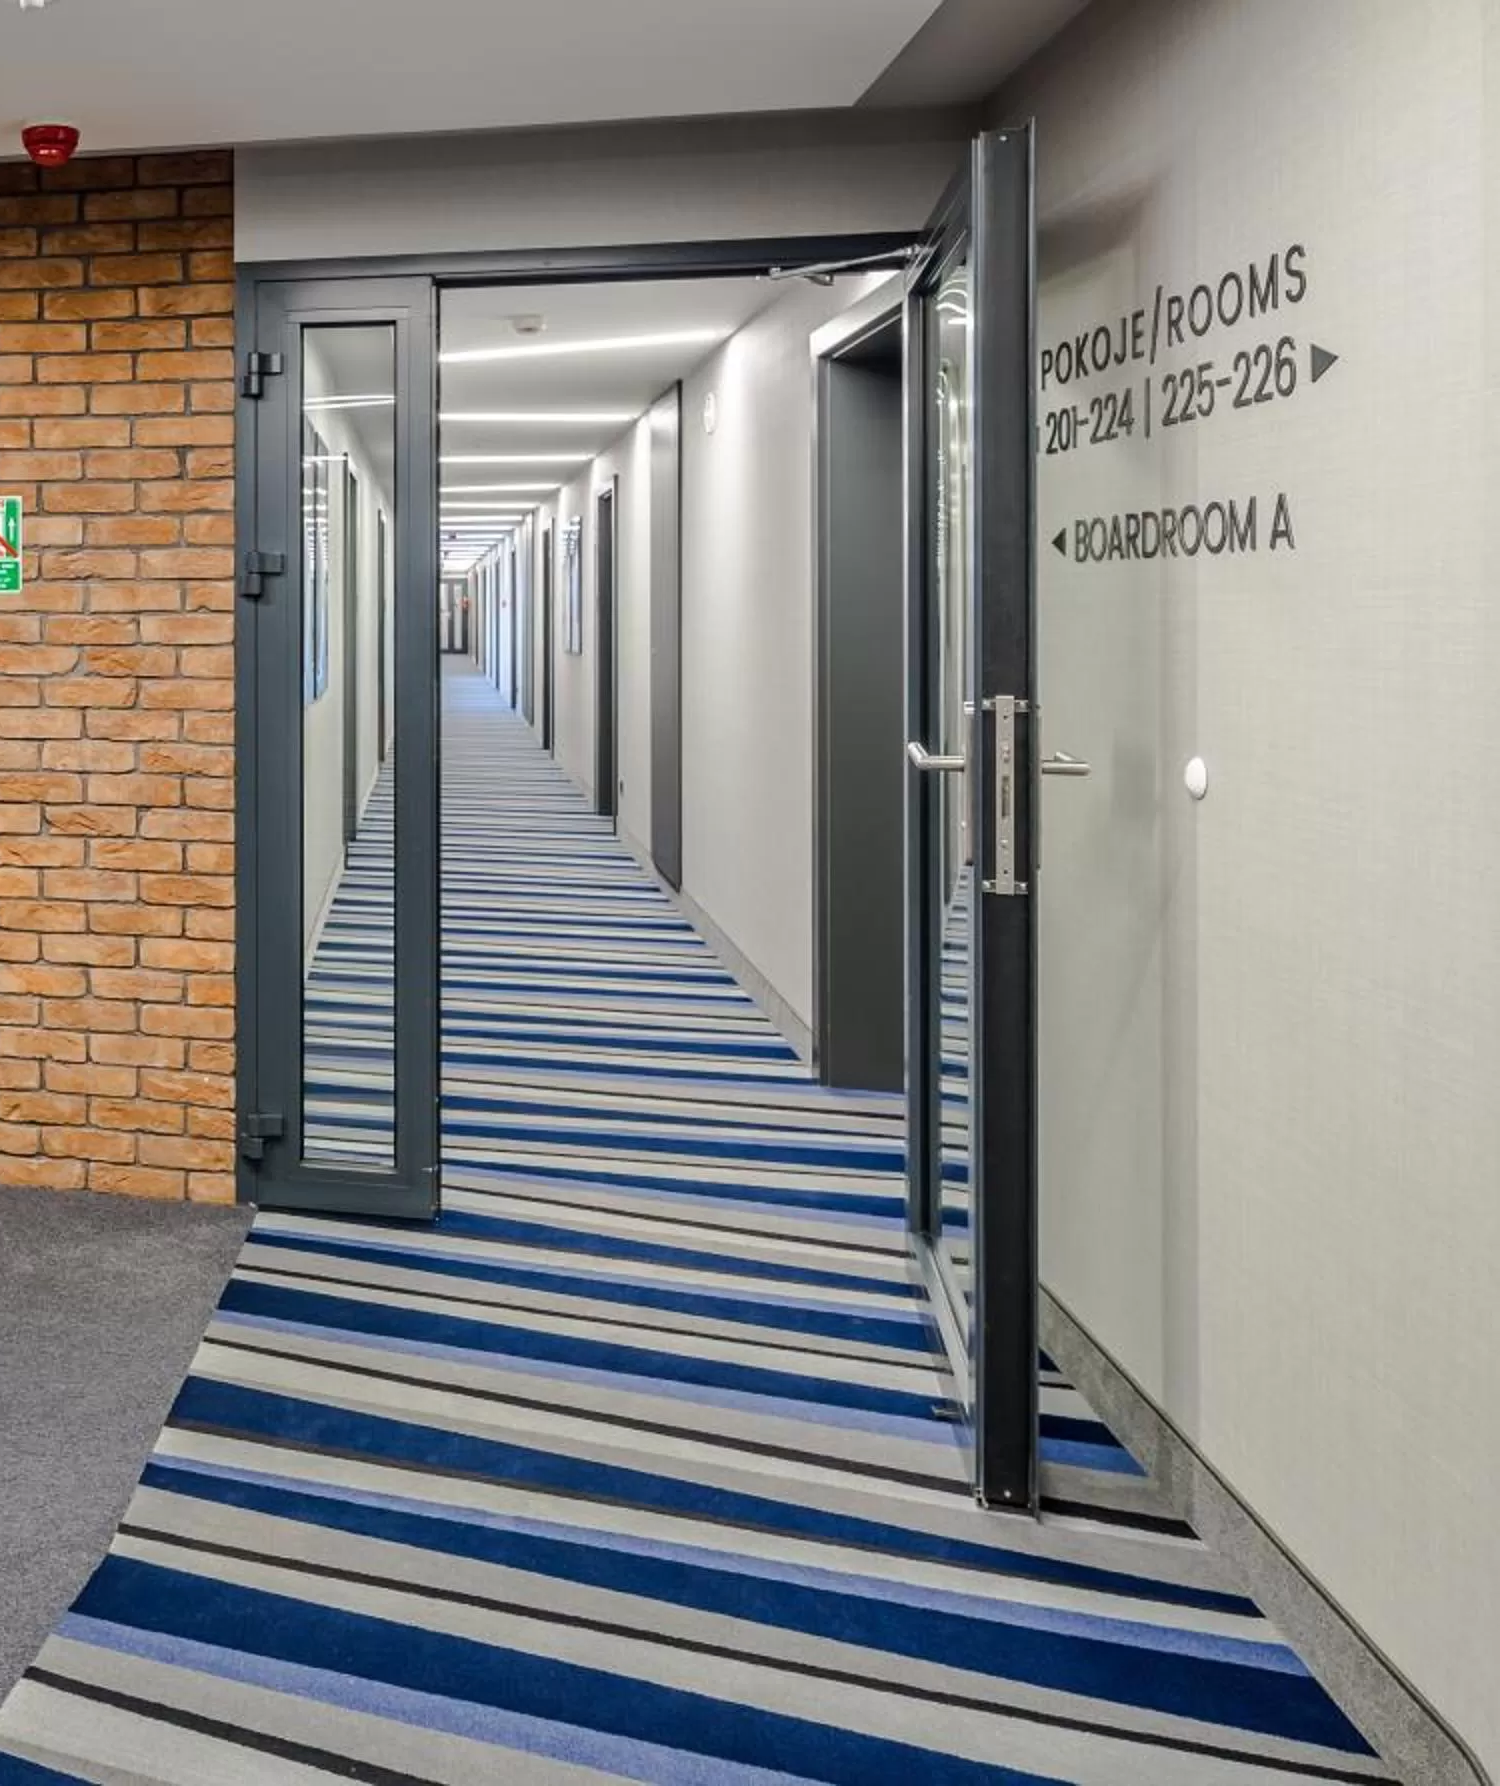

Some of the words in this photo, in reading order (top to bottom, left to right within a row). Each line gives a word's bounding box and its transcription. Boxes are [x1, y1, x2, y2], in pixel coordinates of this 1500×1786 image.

[1045, 387, 1135, 455] 201-224
[1161, 335, 1297, 427] 225-226
[1075, 495, 1257, 563] BOARDROOM
[1269, 493, 1296, 550] A
